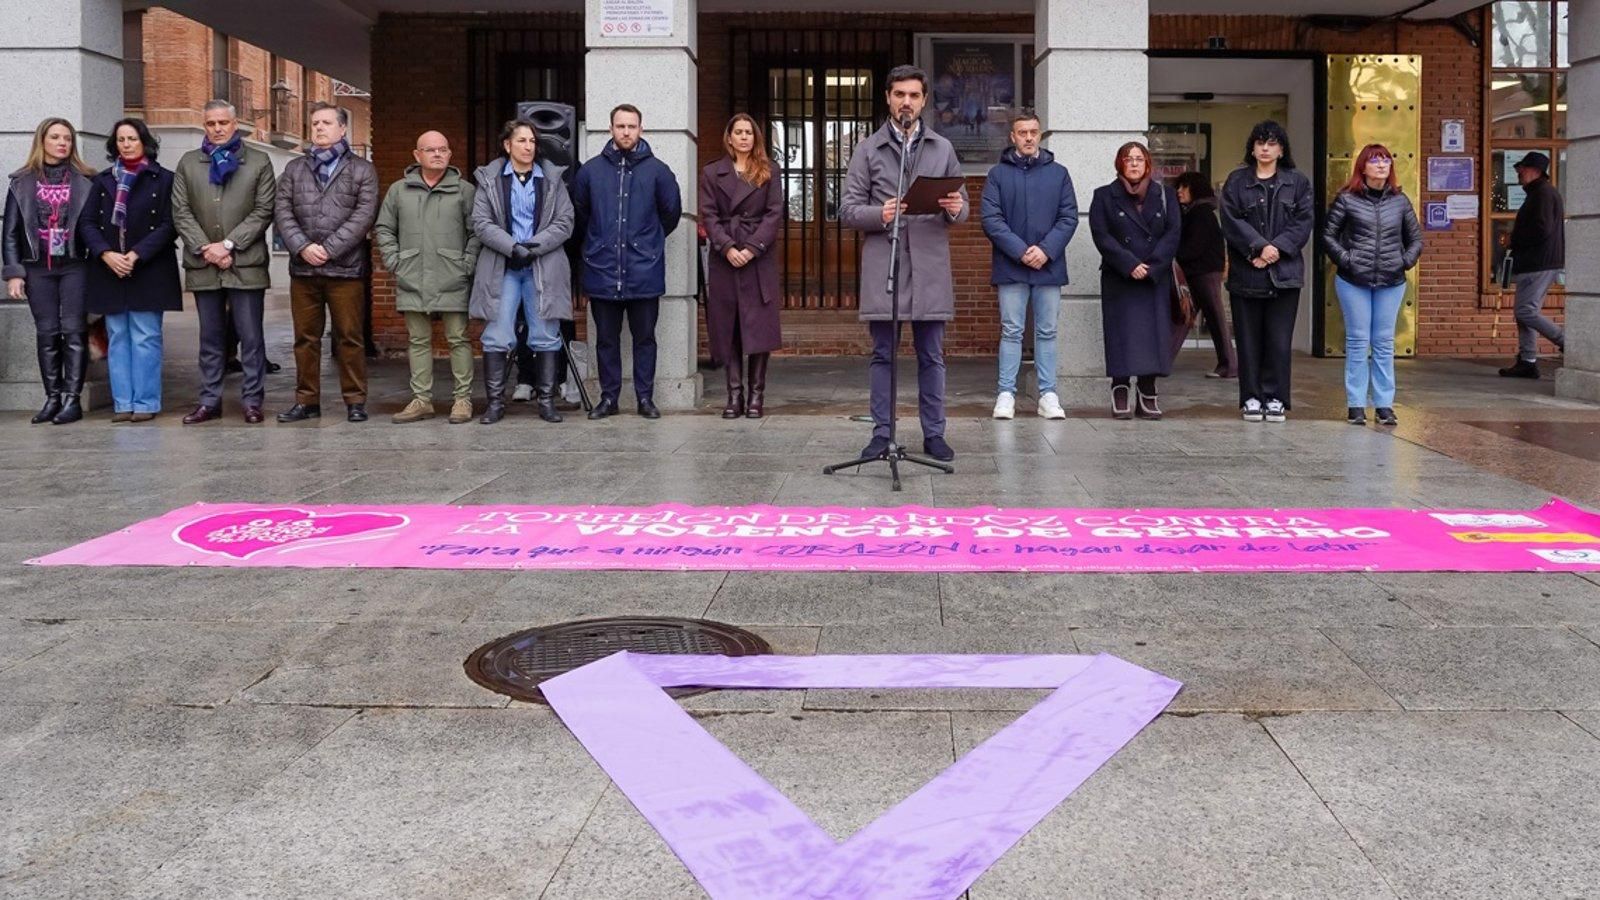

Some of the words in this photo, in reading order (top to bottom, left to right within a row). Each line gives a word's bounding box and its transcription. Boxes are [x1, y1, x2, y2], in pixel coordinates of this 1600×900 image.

[477, 510, 763, 526] TORREJÓN
[776, 512, 851, 526] DE
[862, 512, 1063, 527] ARDOZ
[1074, 514, 1329, 527] CONTRA
[449, 523, 521, 535] LA
[576, 523, 954, 538] VIOLENCIA
[972, 525, 1072, 538] DE
[528, 545, 590, 558] que
[598, 546, 625, 555] a
[632, 544, 743, 557] ningún
[754, 541, 960, 557] CORAZÓN
[969, 543, 1002, 555] le
[1013, 543, 1123, 556] hagan
[1134, 543, 1226, 555] dejar
[1238, 542, 1281, 552] de
